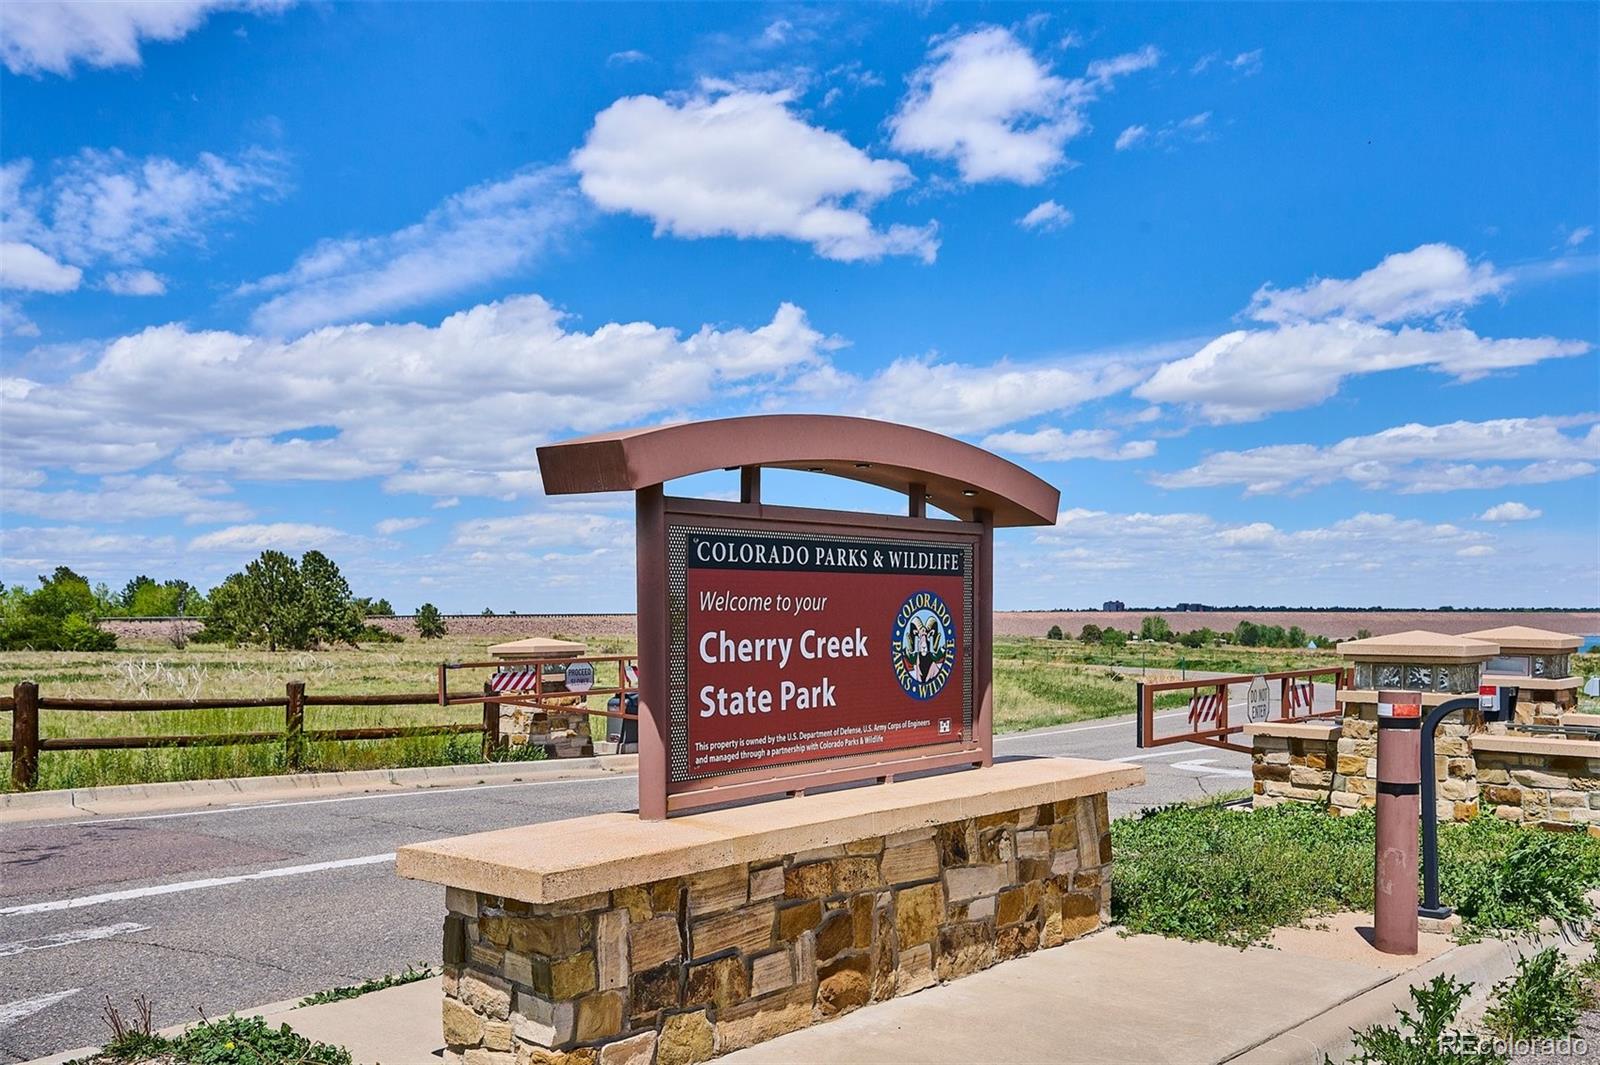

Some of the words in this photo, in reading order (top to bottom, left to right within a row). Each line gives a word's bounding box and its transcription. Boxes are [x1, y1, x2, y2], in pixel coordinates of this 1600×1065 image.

[697, 541, 810, 566] COLORADO
[815, 546, 868, 568] PARKS
[872, 549, 884, 568] &
[888, 550, 960, 571] WILDLIFE
[699, 591, 773, 612] Welcome
[776, 594, 791, 612] to
[793, 596, 827, 616] your
[897, 593, 951, 628] COLORADO
[699, 630, 793, 669] Cherry
[799, 628, 869, 660] Creek
[568, 668, 592, 676] PROCEED
[892, 640, 912, 691] PARKS
[918, 639, 955, 699] WILDLIFE
[700, 685, 772, 718] State
[780, 677, 837, 709] Park
[1250, 689, 1257, 703] DO
[1258, 688, 1268, 702] NOT
[1251, 704, 1267, 719] ENTER
[695, 742, 709, 751] This
[710, 740, 738, 751] property
[739, 738, 745, 747] is
[746, 735, 767, 745] owned
[767, 735, 776, 745] by
[776, 734, 786, 742] the
[787, 732, 799, 741] U.S.
[799, 729, 833, 740] Department
[833, 728, 840, 737] of
[840, 726, 862, 737] Defense,
[863, 723, 874, 733] U.S.
[874, 722, 888, 734] Army
[887, 720, 901, 730] Corps
[901, 720, 908, 728] of
[907, 719, 930, 729] Engineers
[695, 756, 708, 765] and
[709, 752, 740, 763] managed
[740, 748, 766, 759] through
[766, 749, 771, 757] a
[771, 744, 806, 757] partnership
[806, 741, 819, 751] with
[819, 738, 845, 750] Colorado
[844, 736, 860, 747] Parks
[859, 736, 865, 744] &
[865, 735, 884, 743] Wildlife
